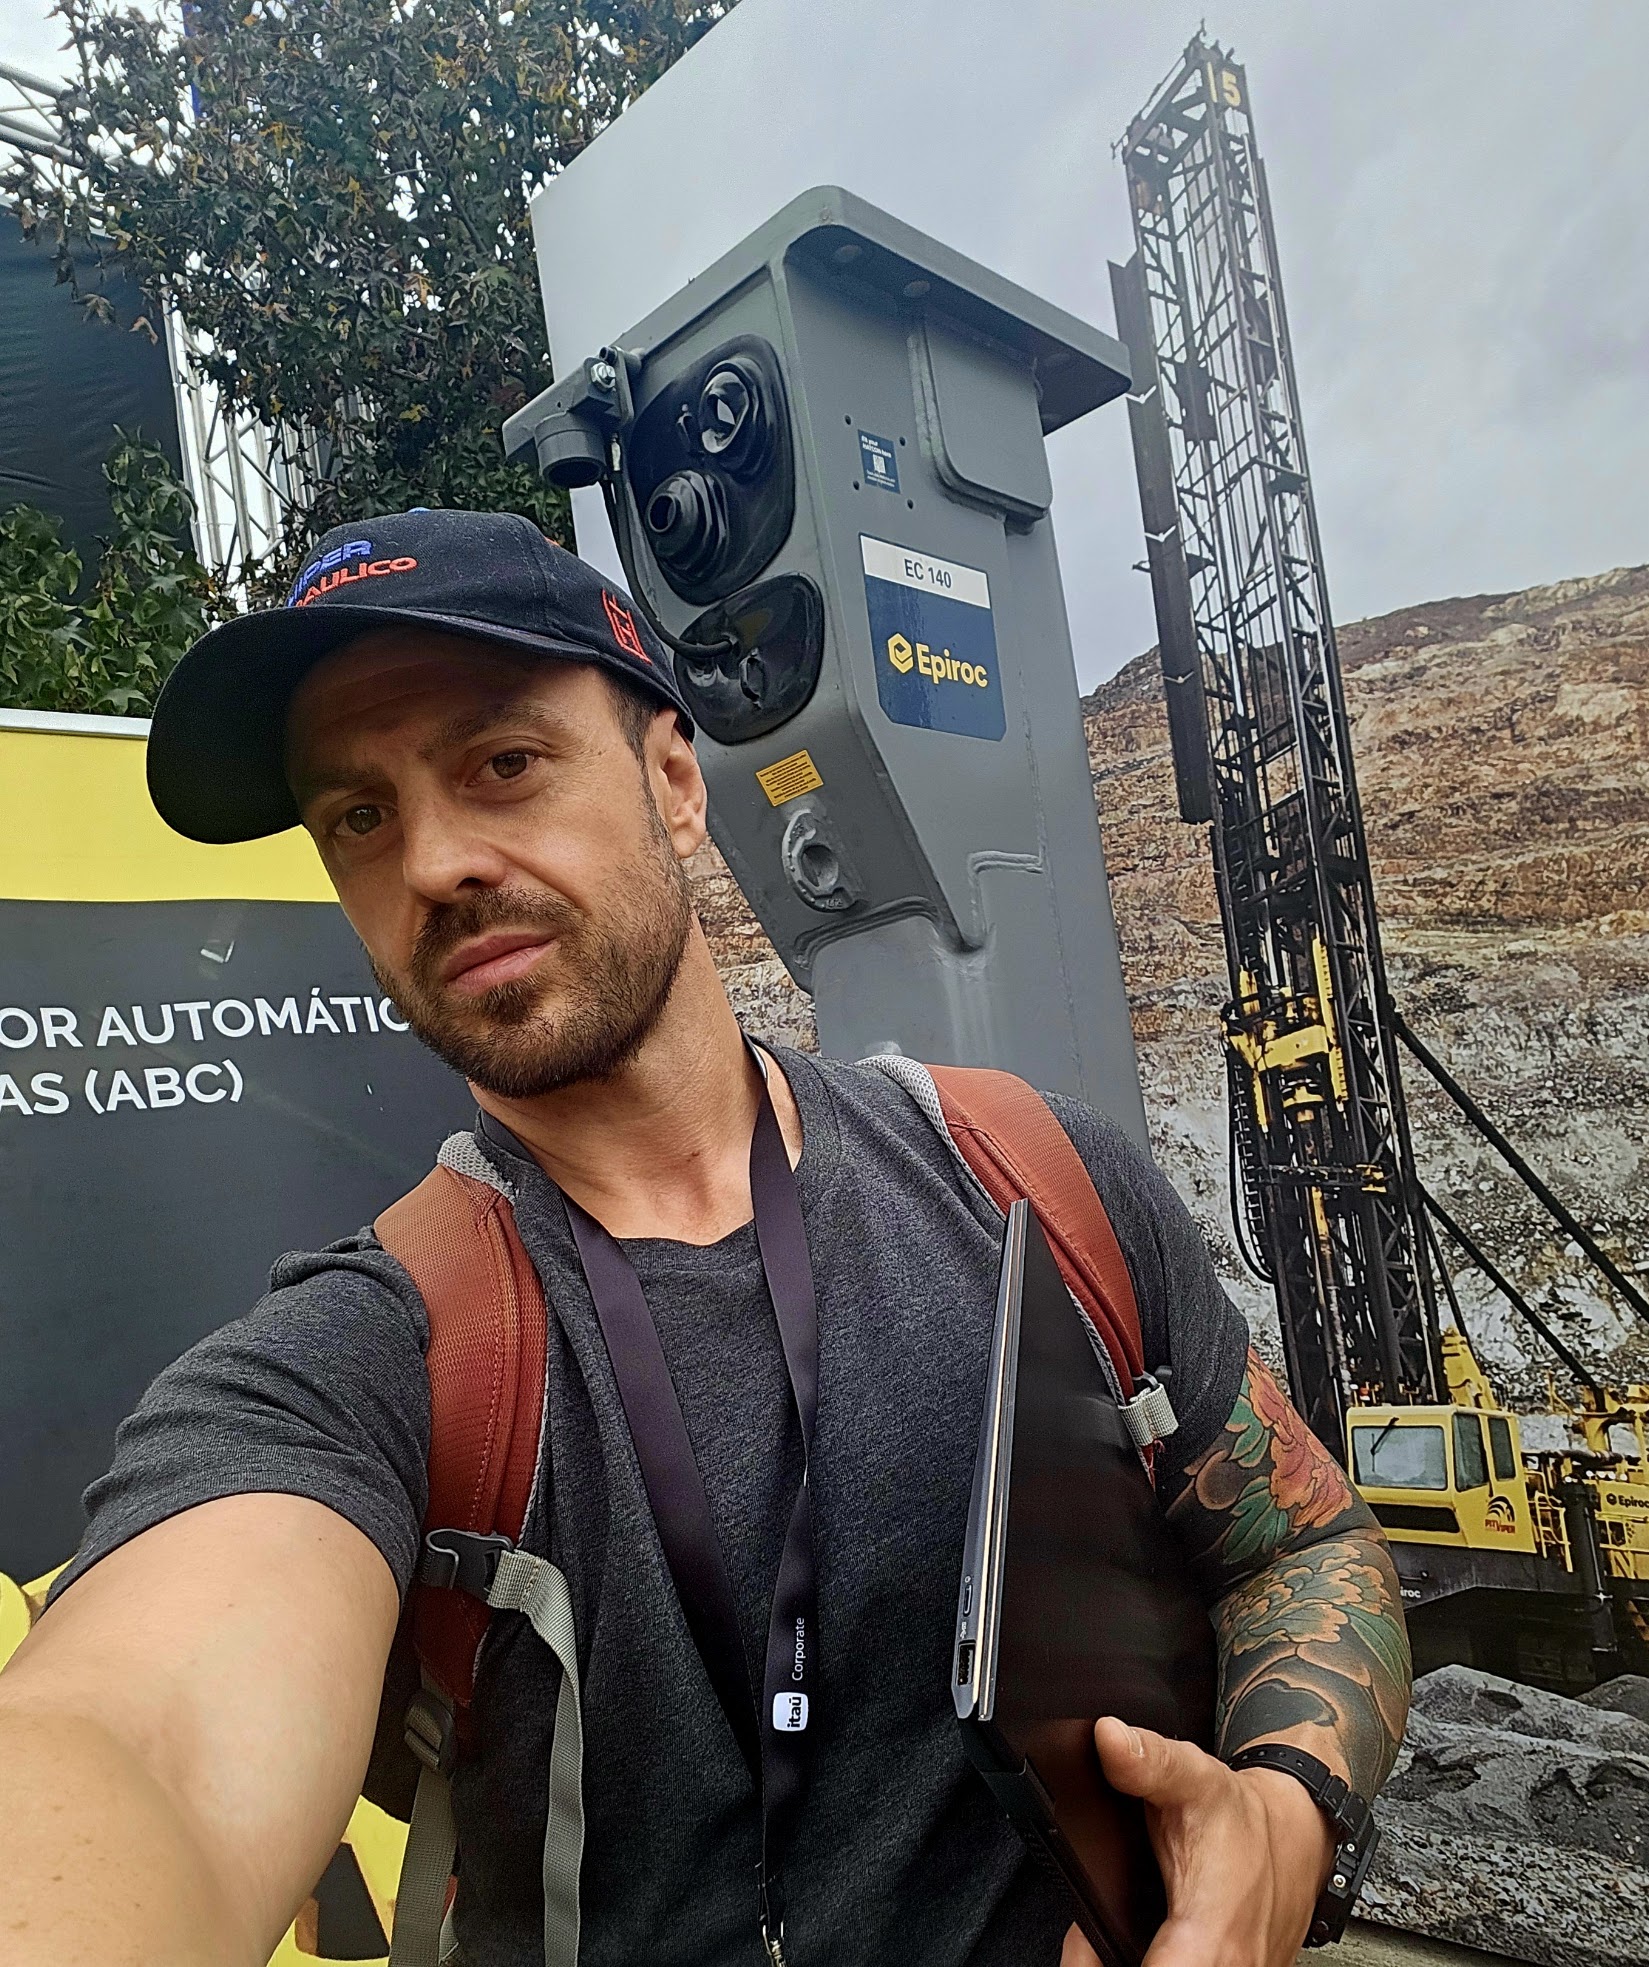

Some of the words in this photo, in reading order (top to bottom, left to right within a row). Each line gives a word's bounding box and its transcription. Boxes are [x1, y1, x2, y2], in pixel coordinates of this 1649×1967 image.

[904, 558, 925, 580] EC
[928, 566, 952, 589] 140
[915, 642, 989, 688] Epiroc
[84, 1059, 244, 1115] (ABC)
[1618, 1495, 1649, 1509] Epiroc
[1400, 1585, 1422, 1599] iroc
[791, 1617, 807, 1681] Corporate
